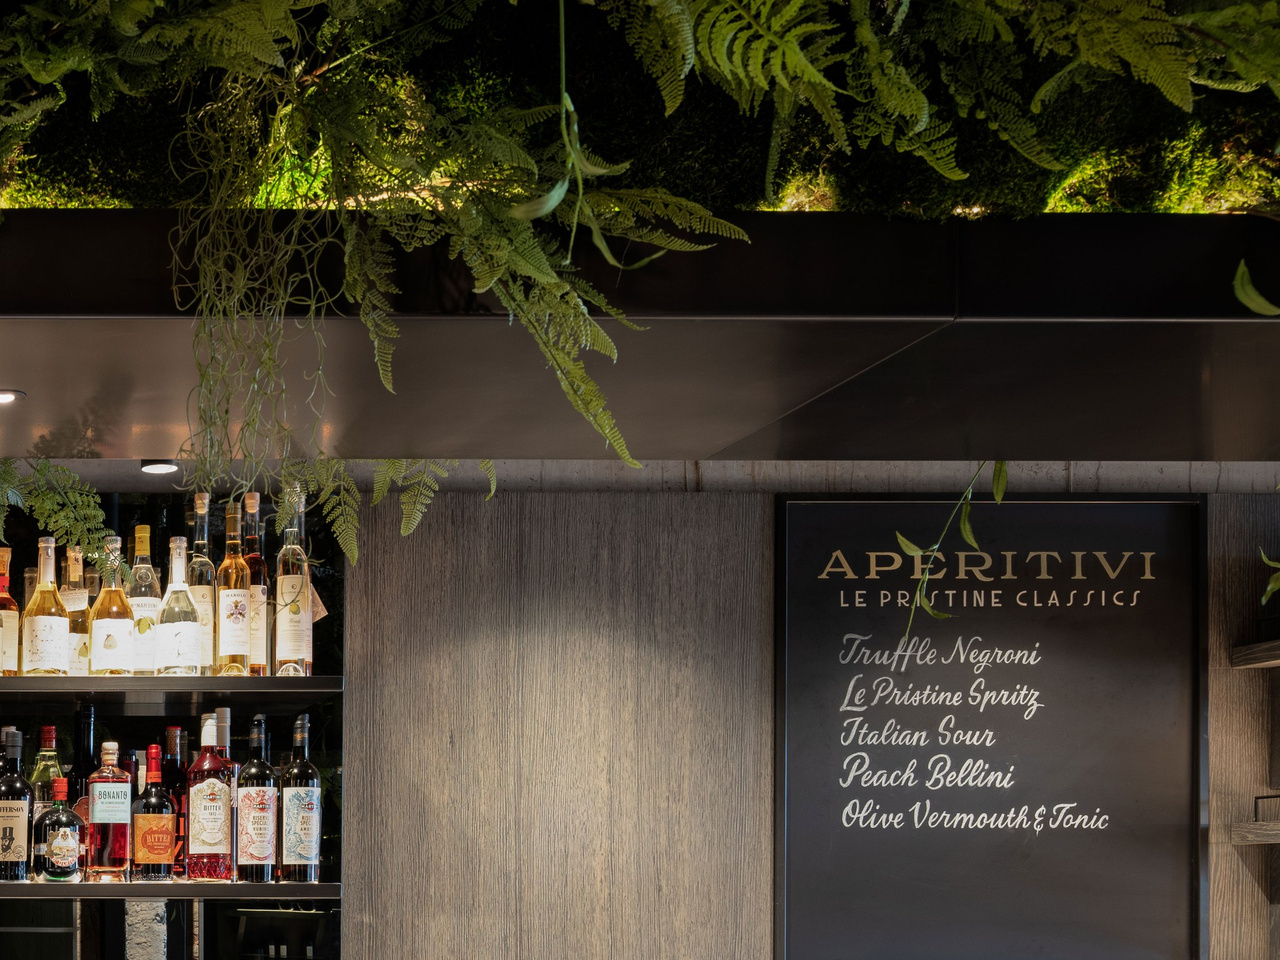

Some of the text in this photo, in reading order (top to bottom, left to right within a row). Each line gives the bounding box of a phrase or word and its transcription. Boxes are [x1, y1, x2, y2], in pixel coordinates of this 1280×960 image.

[817, 549, 1157, 582] APERITIVI
[839, 590, 1141, 608] LE PRISTINE CLASSICS
[839, 633, 1041, 675] Truffle Negroni
[839, 674, 1045, 720] Le Pristine Spritz
[840, 714, 997, 747] Italian Sour
[838, 752, 1015, 790] Peach Bellini
[841, 799, 905, 829] Olive
[908, 799, 1031, 829] Vermouth
[1049, 803, 1109, 829] Tonic
